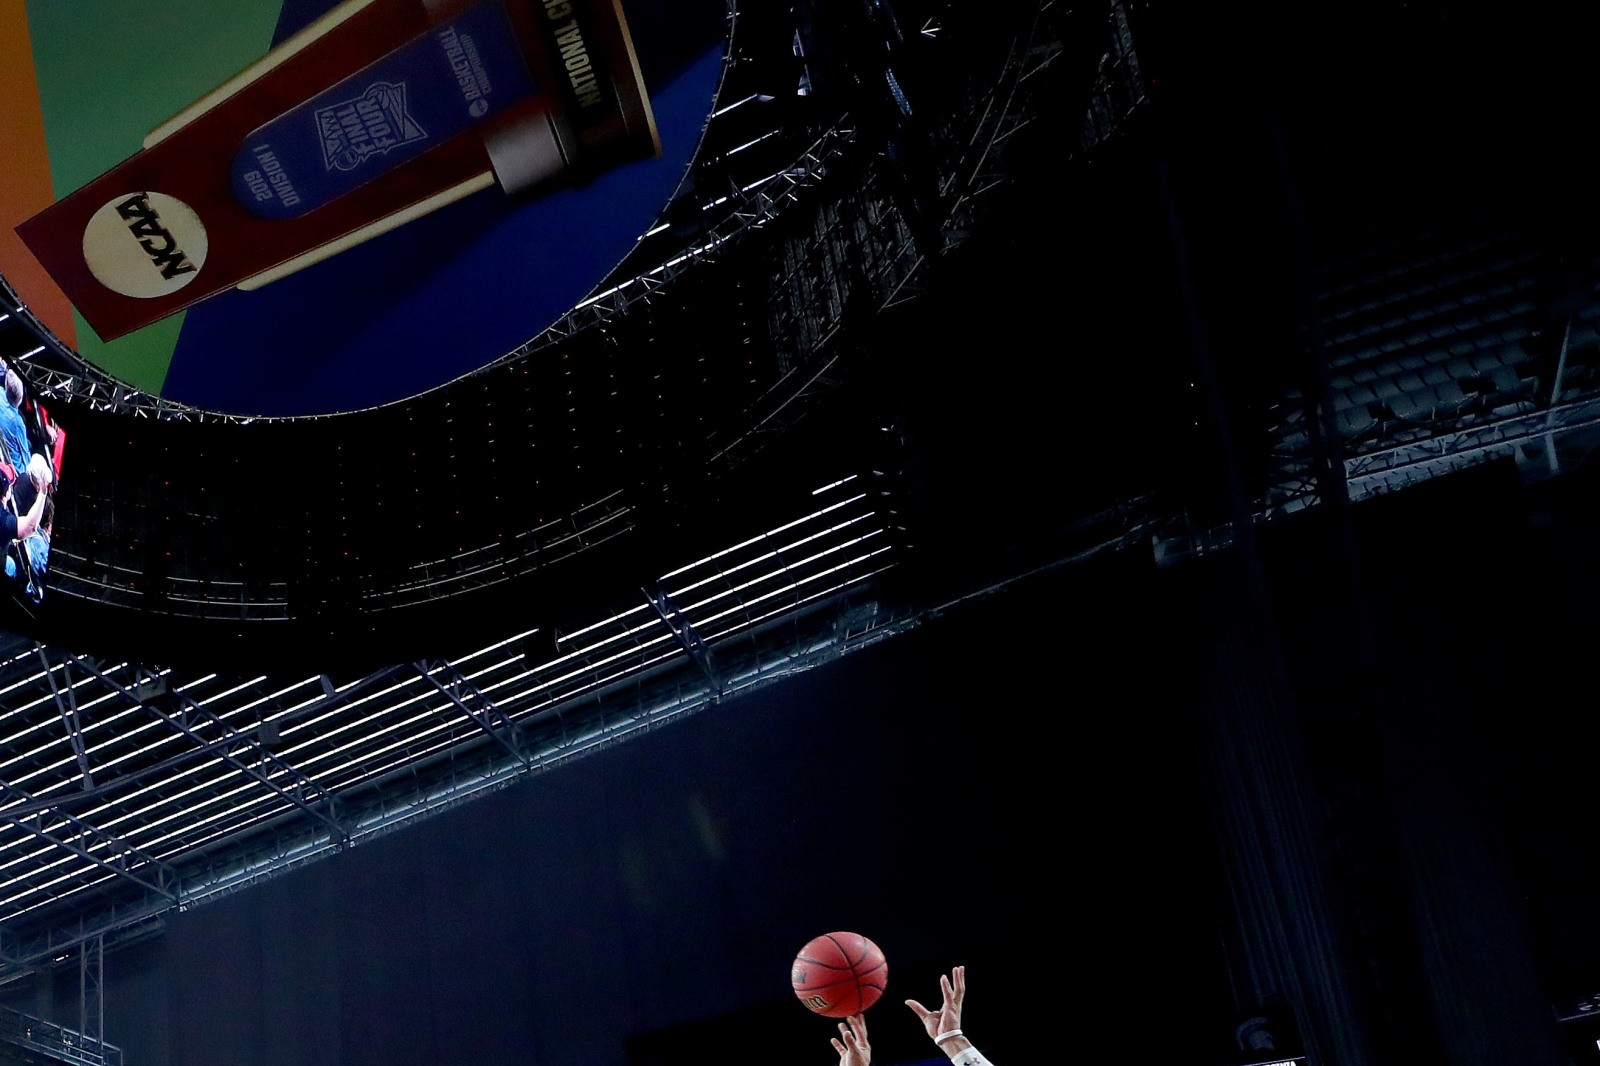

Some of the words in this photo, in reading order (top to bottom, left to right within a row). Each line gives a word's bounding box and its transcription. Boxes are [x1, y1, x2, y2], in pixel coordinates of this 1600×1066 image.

[553, 18, 603, 108] NATIONAL
[243, 169, 273, 202] 2019
[256, 151, 301, 208] DIVISION
[115, 192, 197, 280] NCAA
